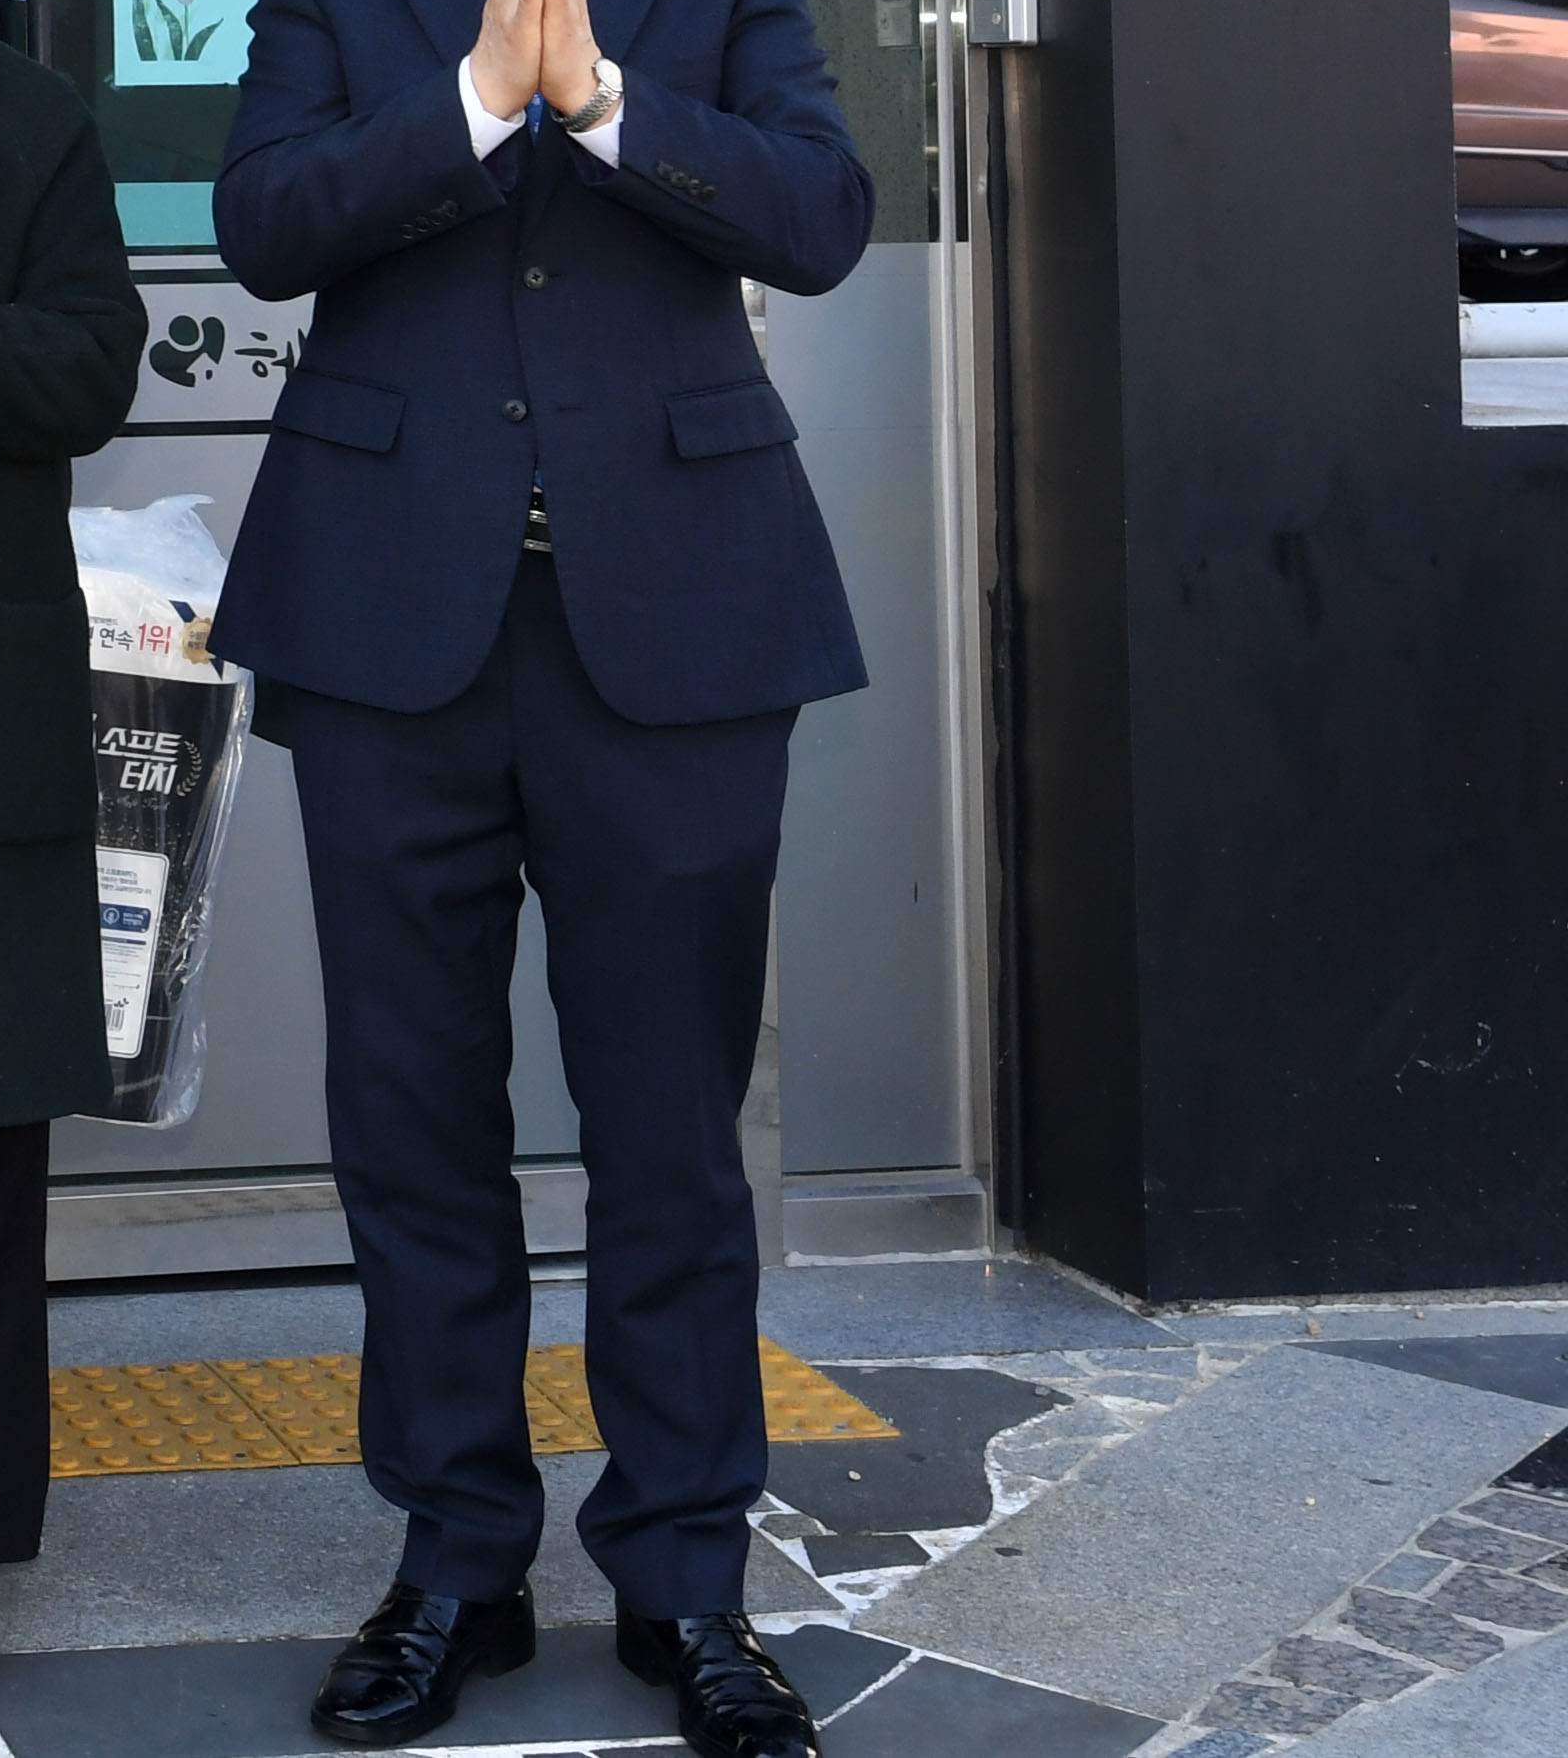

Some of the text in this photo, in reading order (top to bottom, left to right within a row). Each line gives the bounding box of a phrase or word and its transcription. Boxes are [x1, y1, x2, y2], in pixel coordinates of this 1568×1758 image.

[99, 627, 134, 652] 연속
[138, 622, 172, 654] 1위
[97, 727, 183, 763] 소프트
[119, 760, 179, 795] 터치
